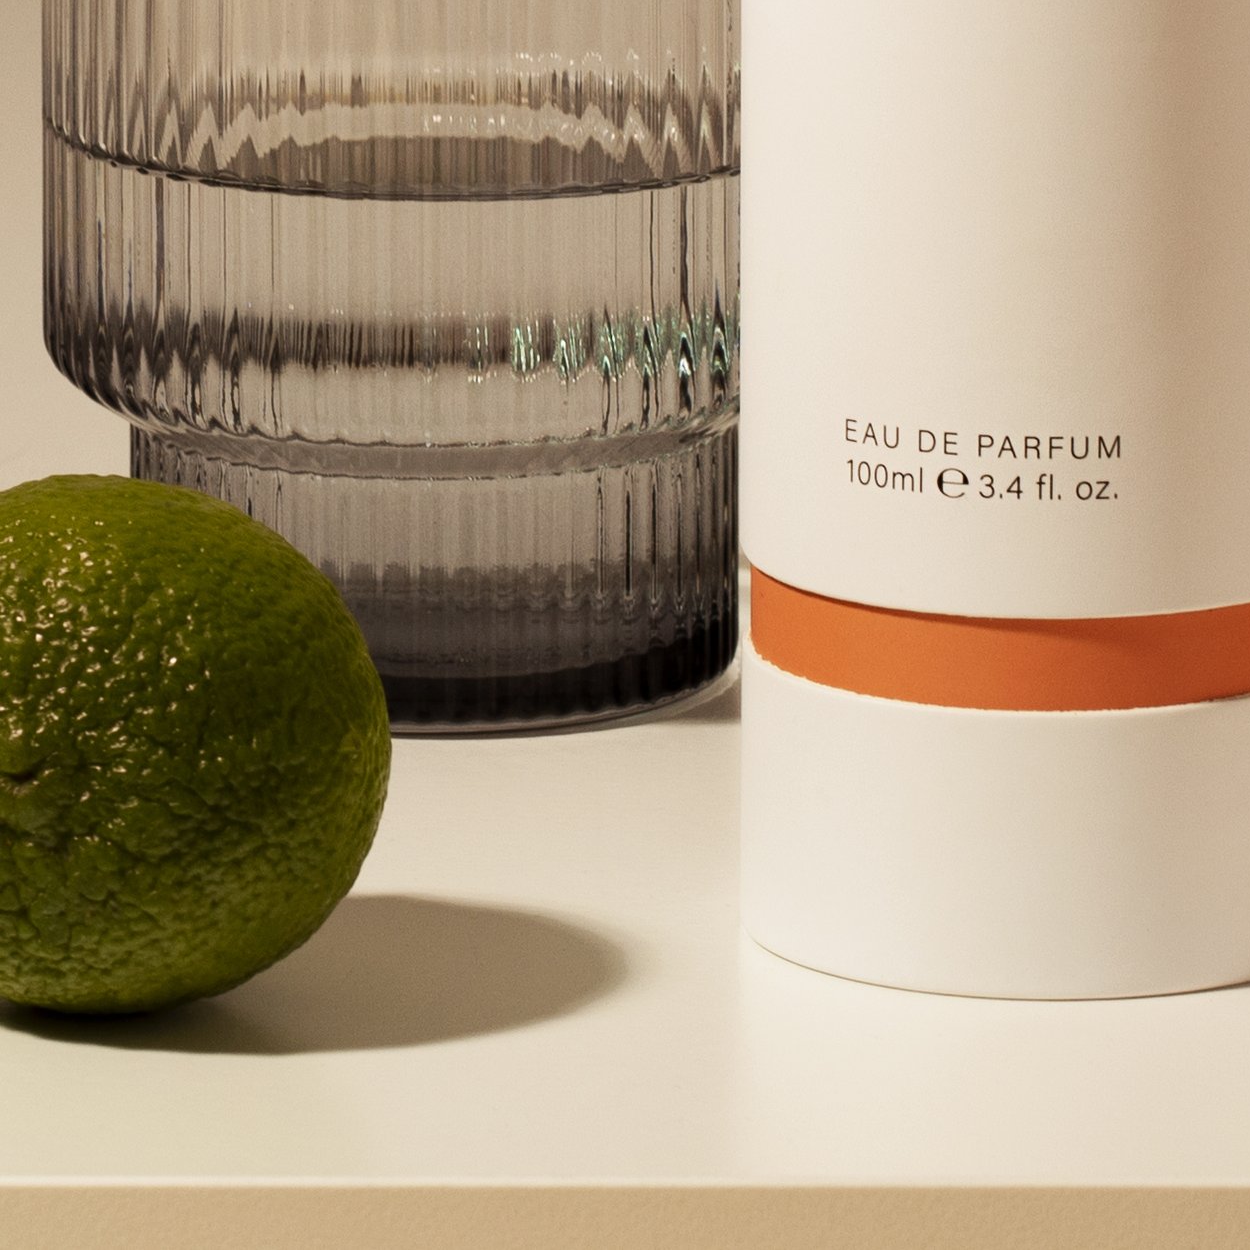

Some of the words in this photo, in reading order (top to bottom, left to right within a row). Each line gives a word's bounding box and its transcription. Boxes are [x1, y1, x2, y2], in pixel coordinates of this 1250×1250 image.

[845, 418, 900, 449] EAU
[918, 429, 959, 456] DE
[977, 434, 1122, 460] PARFUM
[847, 459, 923, 493] 100ml
[978, 473, 1023, 500] 3.4
[1036, 473, 1062, 500] fl.
[1075, 480, 1118, 500] oz.
